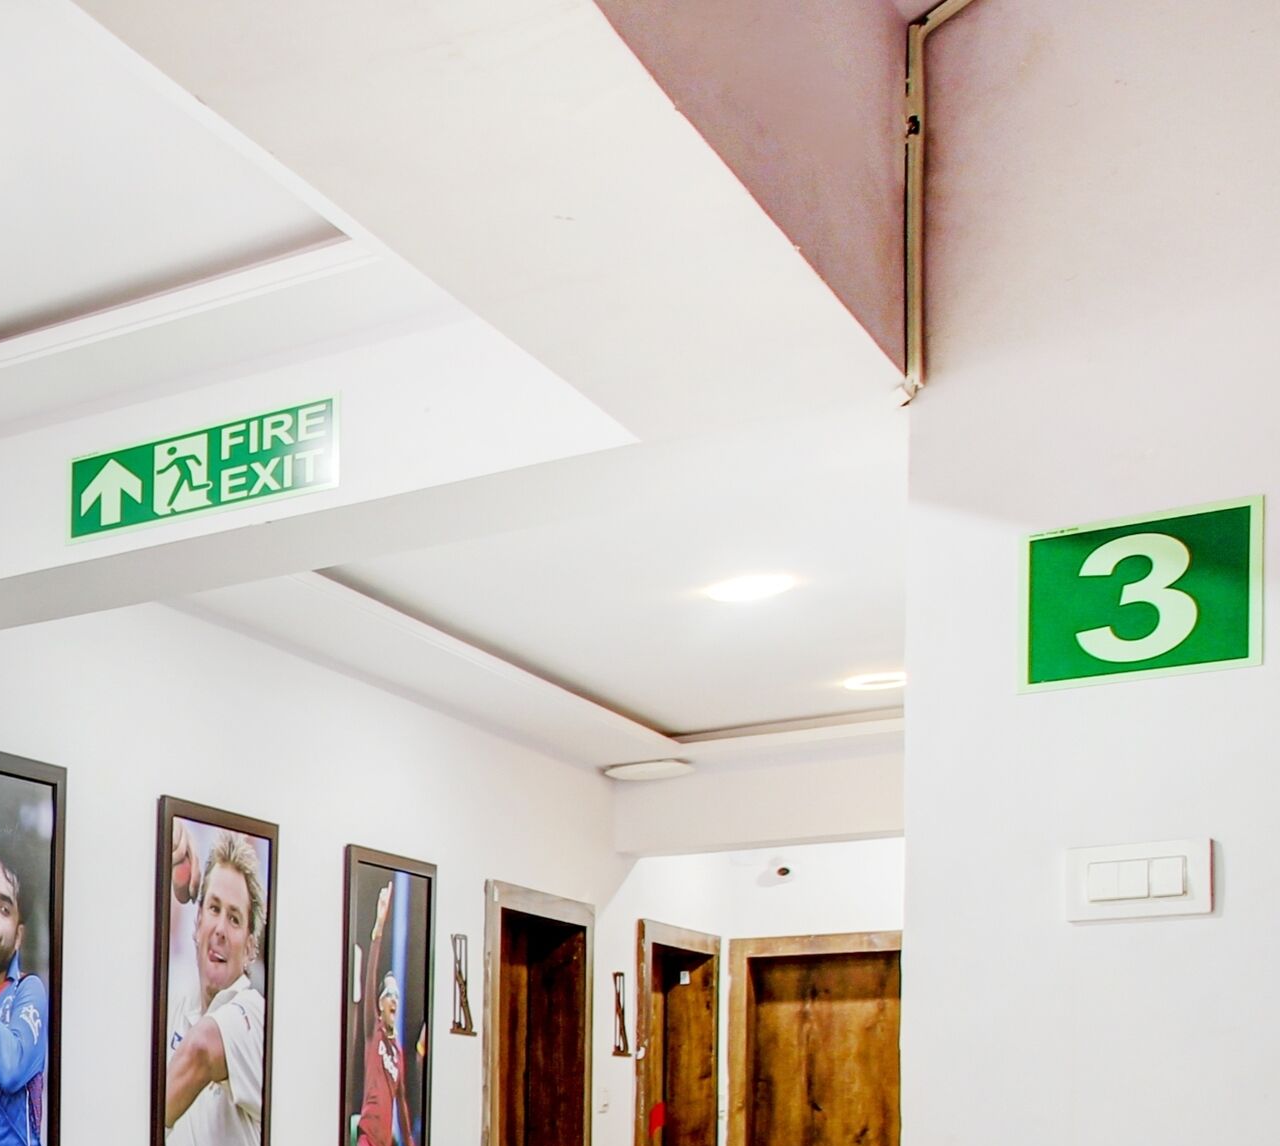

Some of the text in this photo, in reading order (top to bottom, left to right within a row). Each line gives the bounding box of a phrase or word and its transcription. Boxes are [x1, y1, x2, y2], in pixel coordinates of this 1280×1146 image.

[221, 403, 328, 461] FIRE
[220, 448, 325, 503] EXIT
[1074, 532, 1198, 663] 3
